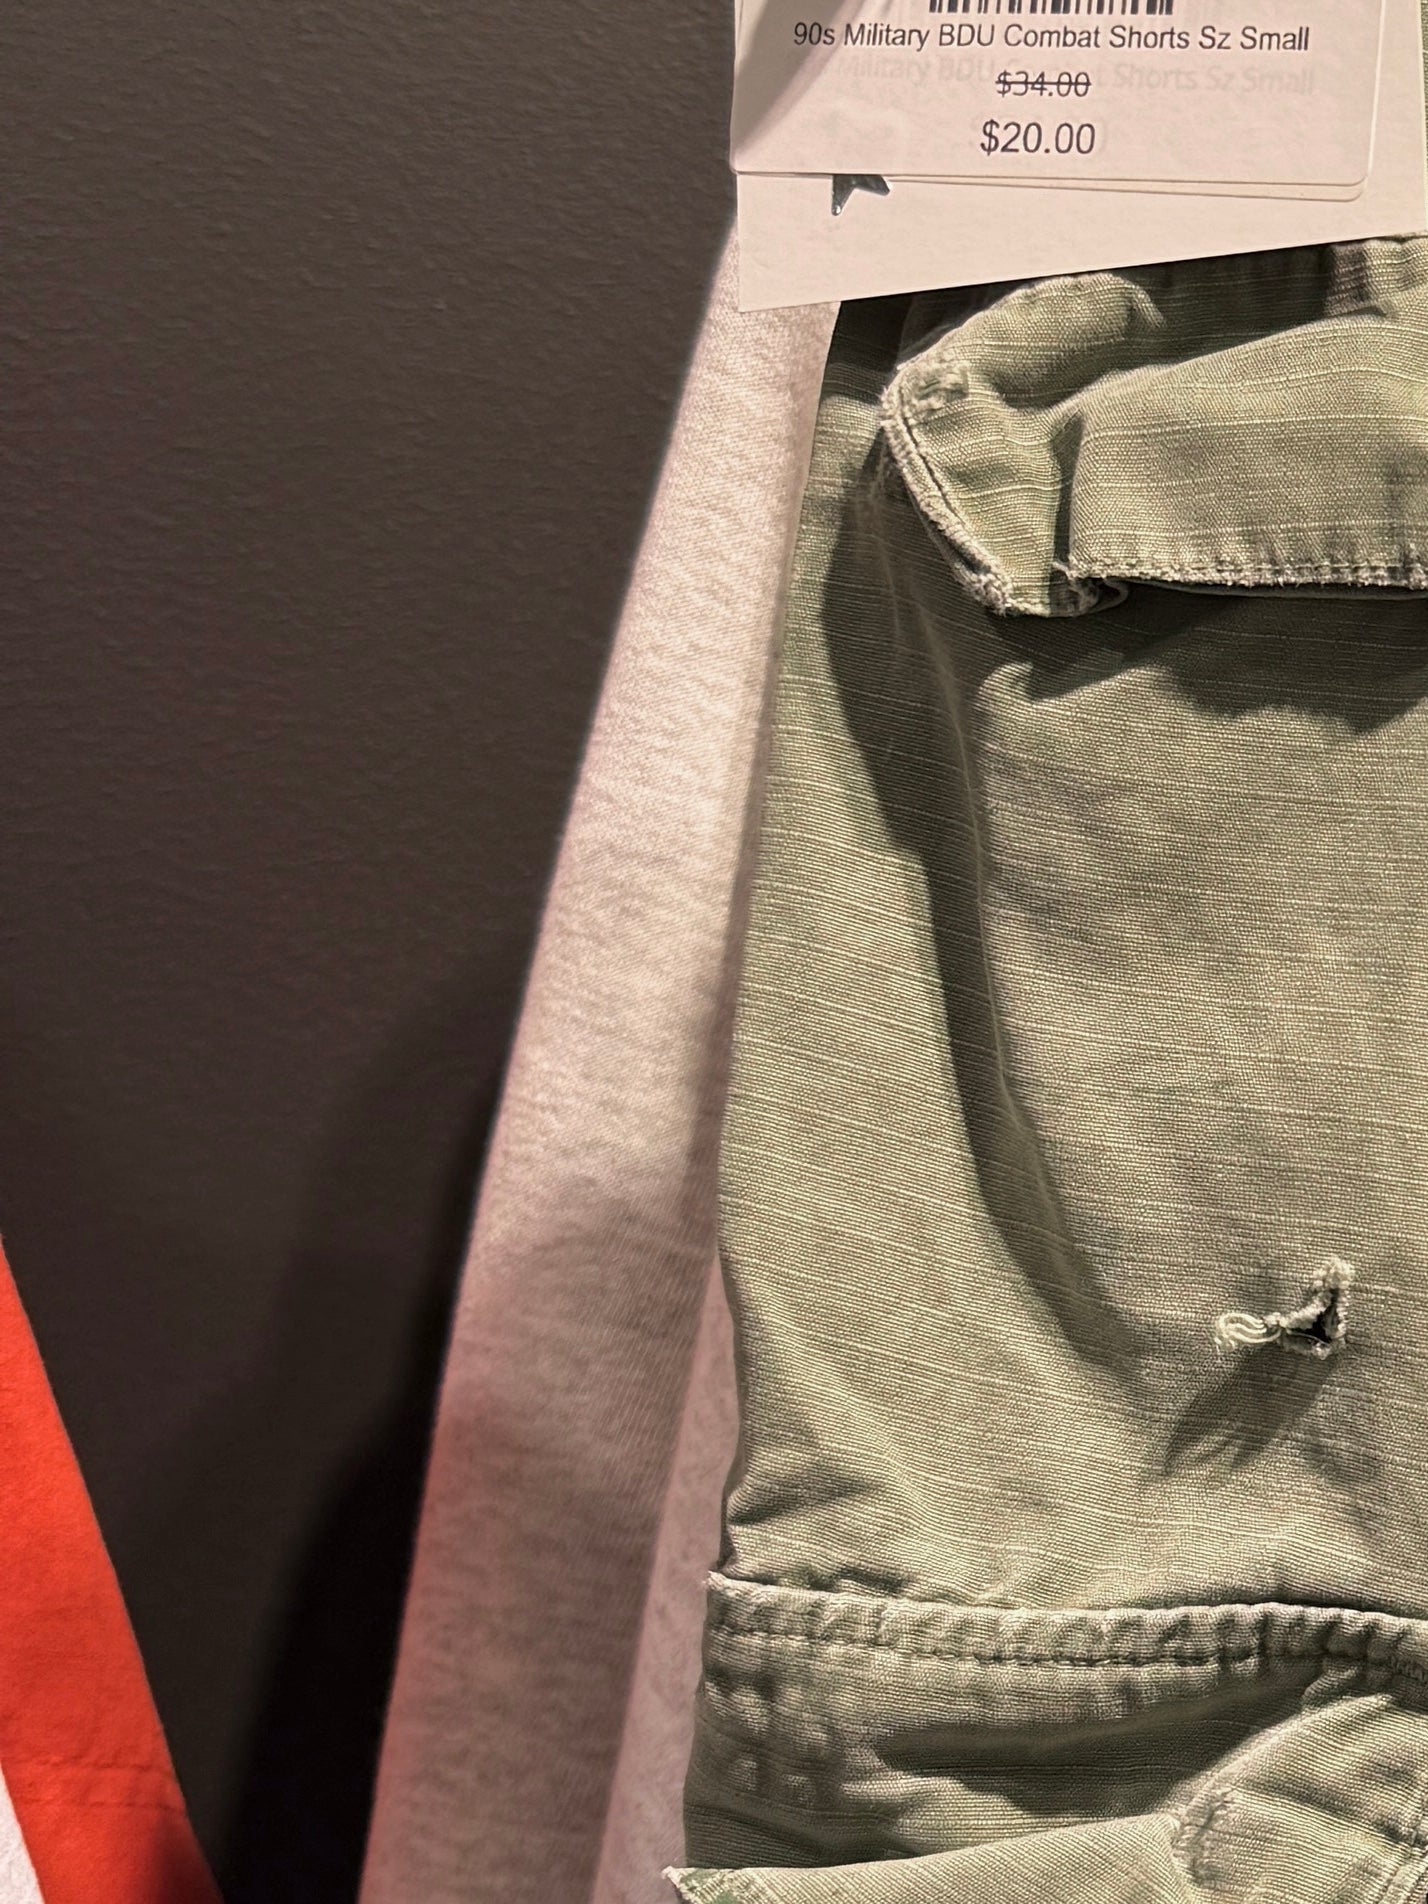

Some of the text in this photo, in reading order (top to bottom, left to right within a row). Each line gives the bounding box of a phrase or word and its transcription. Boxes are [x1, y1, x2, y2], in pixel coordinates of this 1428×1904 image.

[793, 21, 1310, 52] 90s Military BDU Combat Shorts Sz Small
[995, 69, 1092, 98] $34.00
[979, 118, 1097, 157] $20.00
